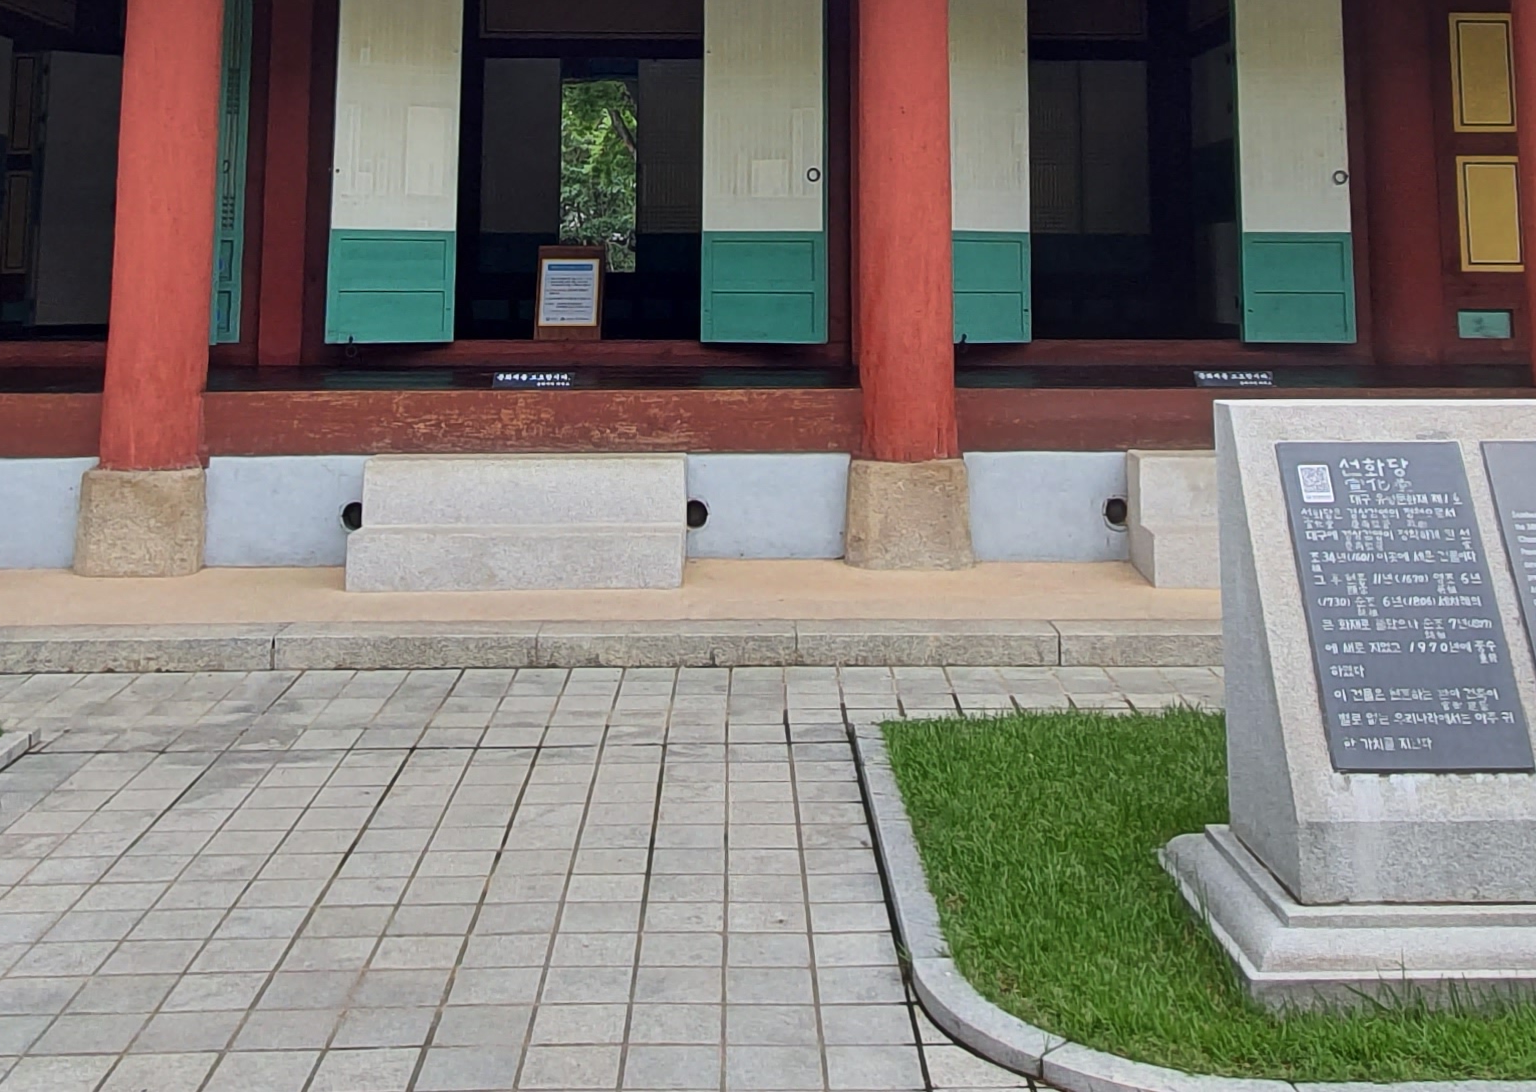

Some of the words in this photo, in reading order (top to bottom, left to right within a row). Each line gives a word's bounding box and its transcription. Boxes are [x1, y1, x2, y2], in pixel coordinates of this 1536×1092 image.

[1339, 458, 1408, 477] 선화당
[1349, 494, 1370, 505] 대구
[1301, 508, 1343, 520] 선화당은
[1305, 530, 1338, 541] 대구에
[1377, 552, 1409, 563] 이곳에
[1313, 575, 1326, 585] 그
[1461, 573, 1482, 584] 6년
[1318, 597, 1351, 607] (1730)
[1338, 618, 1371, 630] 화재로
[1325, 642, 1338, 654] 에
[1343, 642, 1366, 654] 새로
[1409, 641, 1472, 654] 1970년에
[1330, 664, 1365, 678] 하였다
[1333, 688, 1347, 702] 이
[1351, 688, 1386, 702] 건물은
[1338, 712, 1362, 727] 별로
[1474, 712, 1499, 725] 아주
